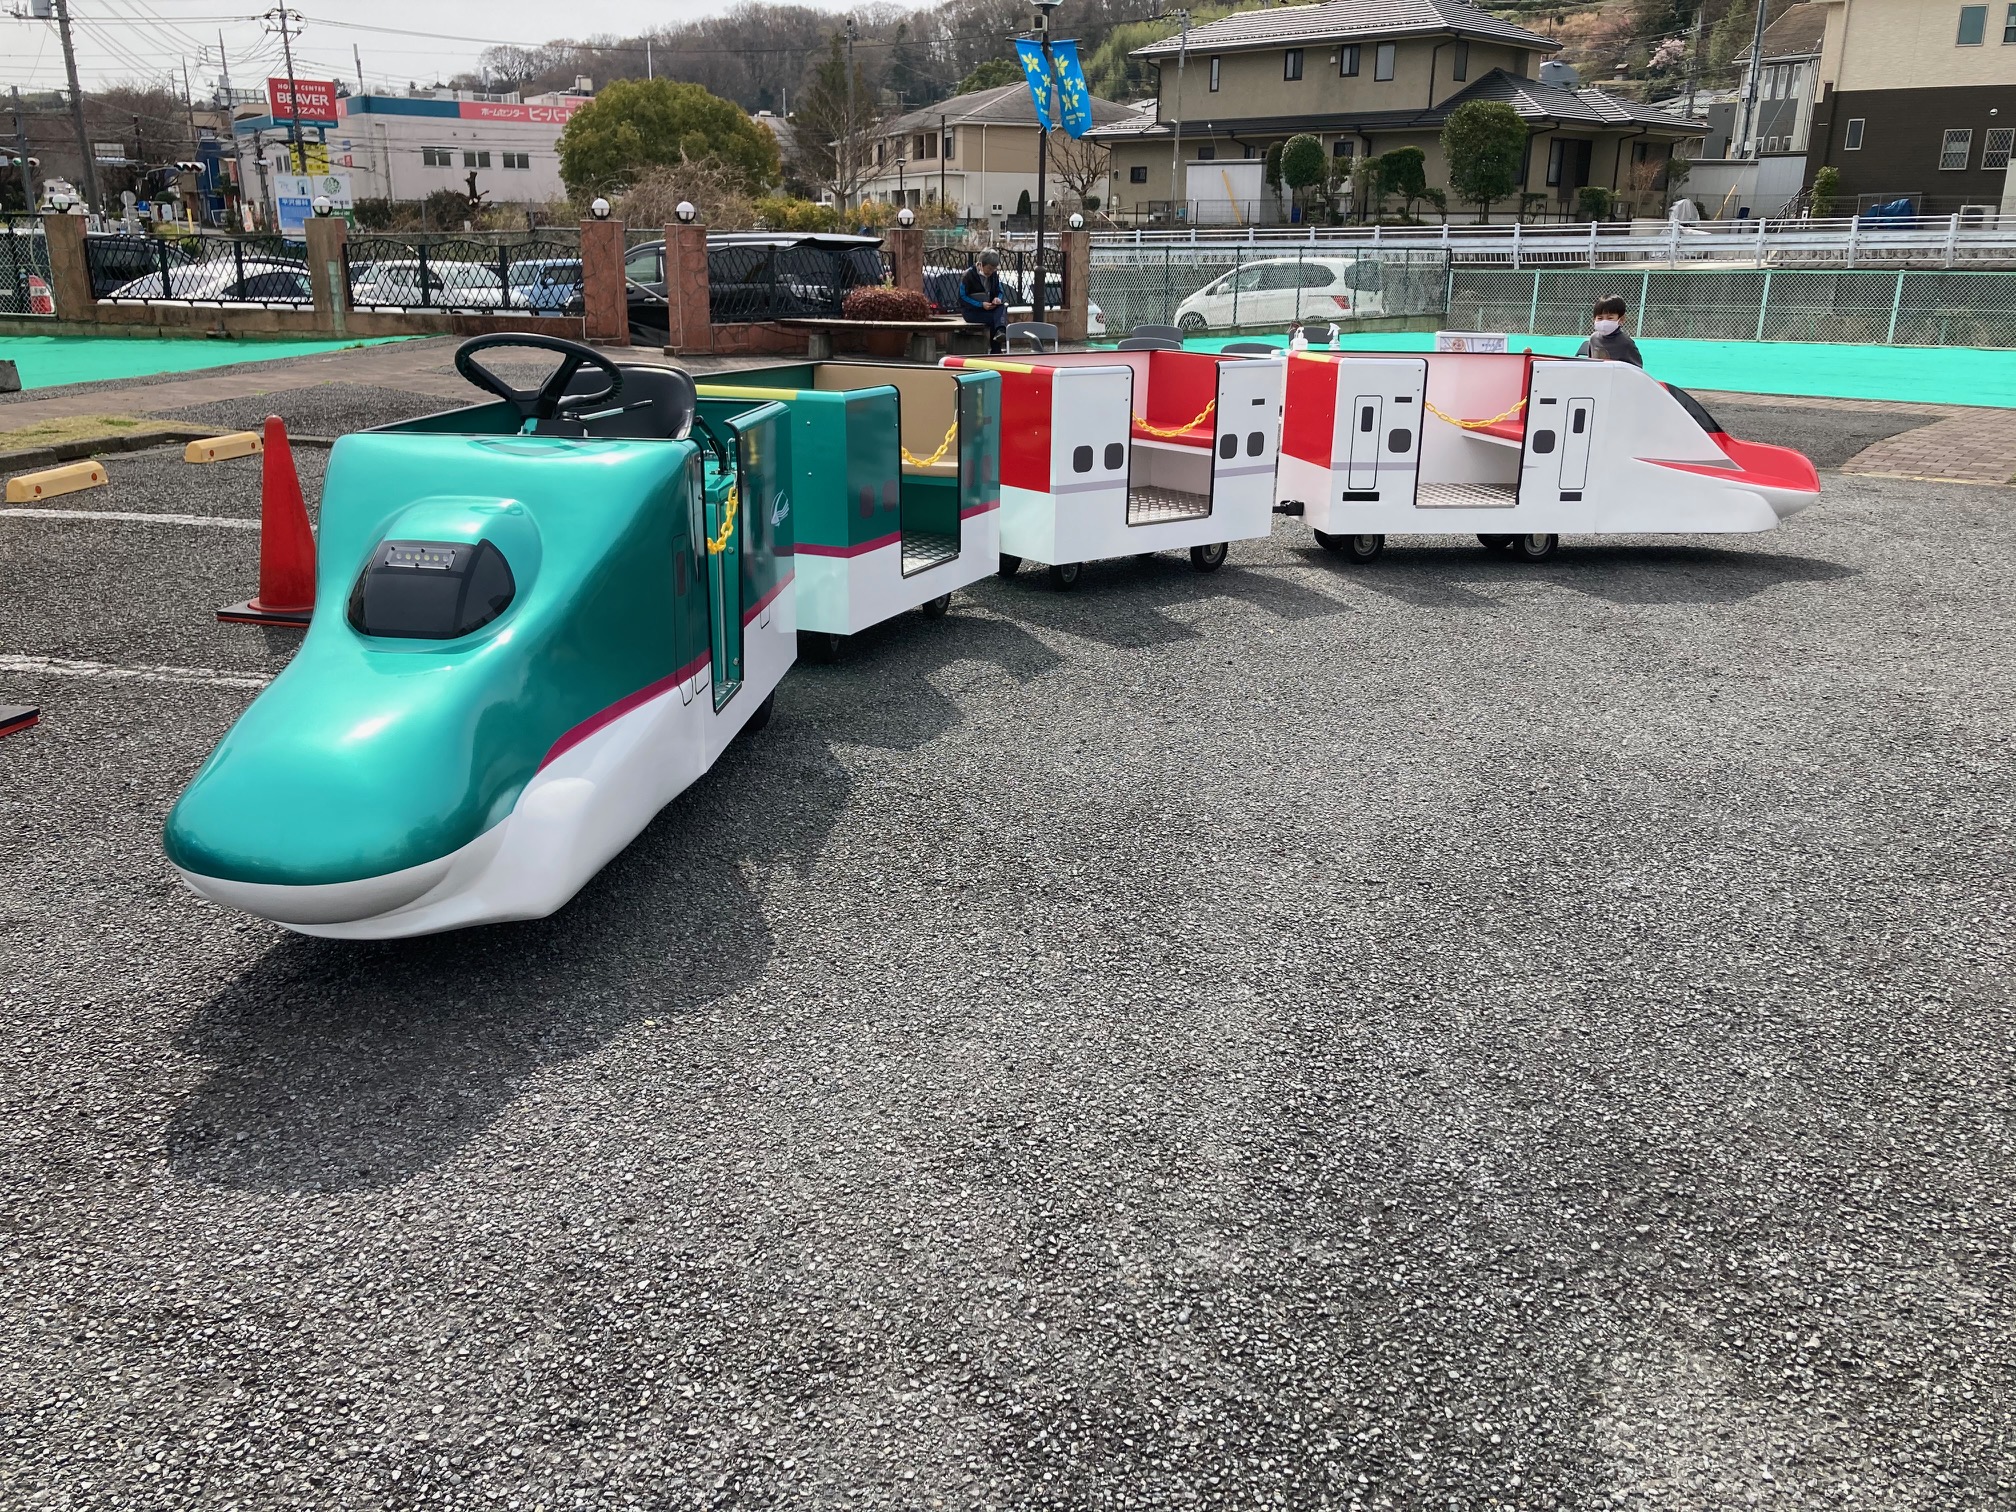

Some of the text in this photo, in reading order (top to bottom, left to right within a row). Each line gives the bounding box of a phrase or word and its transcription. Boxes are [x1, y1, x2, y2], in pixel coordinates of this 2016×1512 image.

[301, 84, 326, 92] CENTER
[277, 91, 330, 106] BEAVER
[481, 108, 525, 117] ホームセンター
